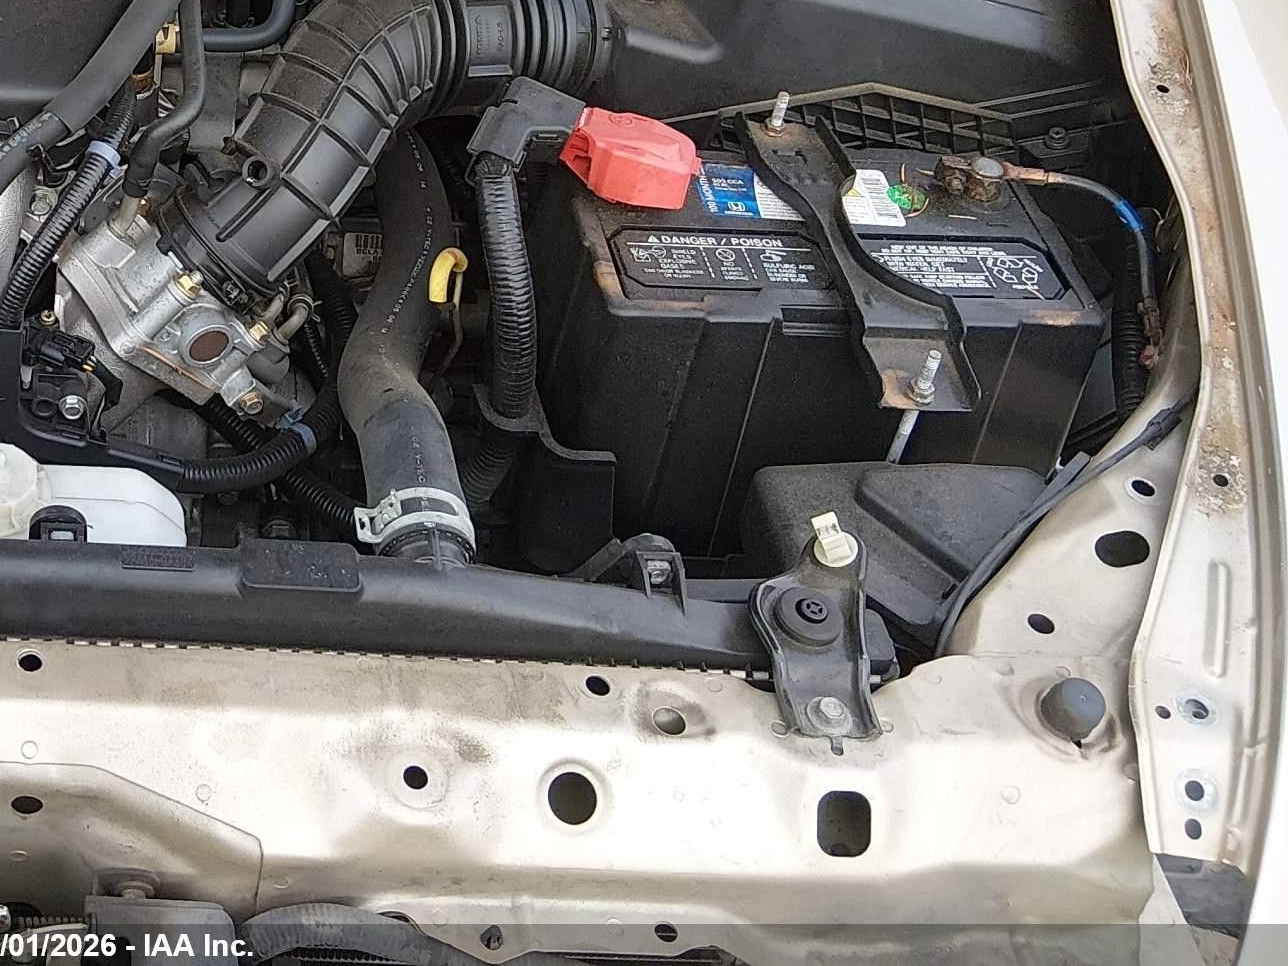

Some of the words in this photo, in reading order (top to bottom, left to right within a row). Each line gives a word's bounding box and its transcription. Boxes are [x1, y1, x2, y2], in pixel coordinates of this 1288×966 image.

[661, 235, 717, 246] DANGER
[720, 235, 727, 246] /
[732, 238, 784, 248] POISON
